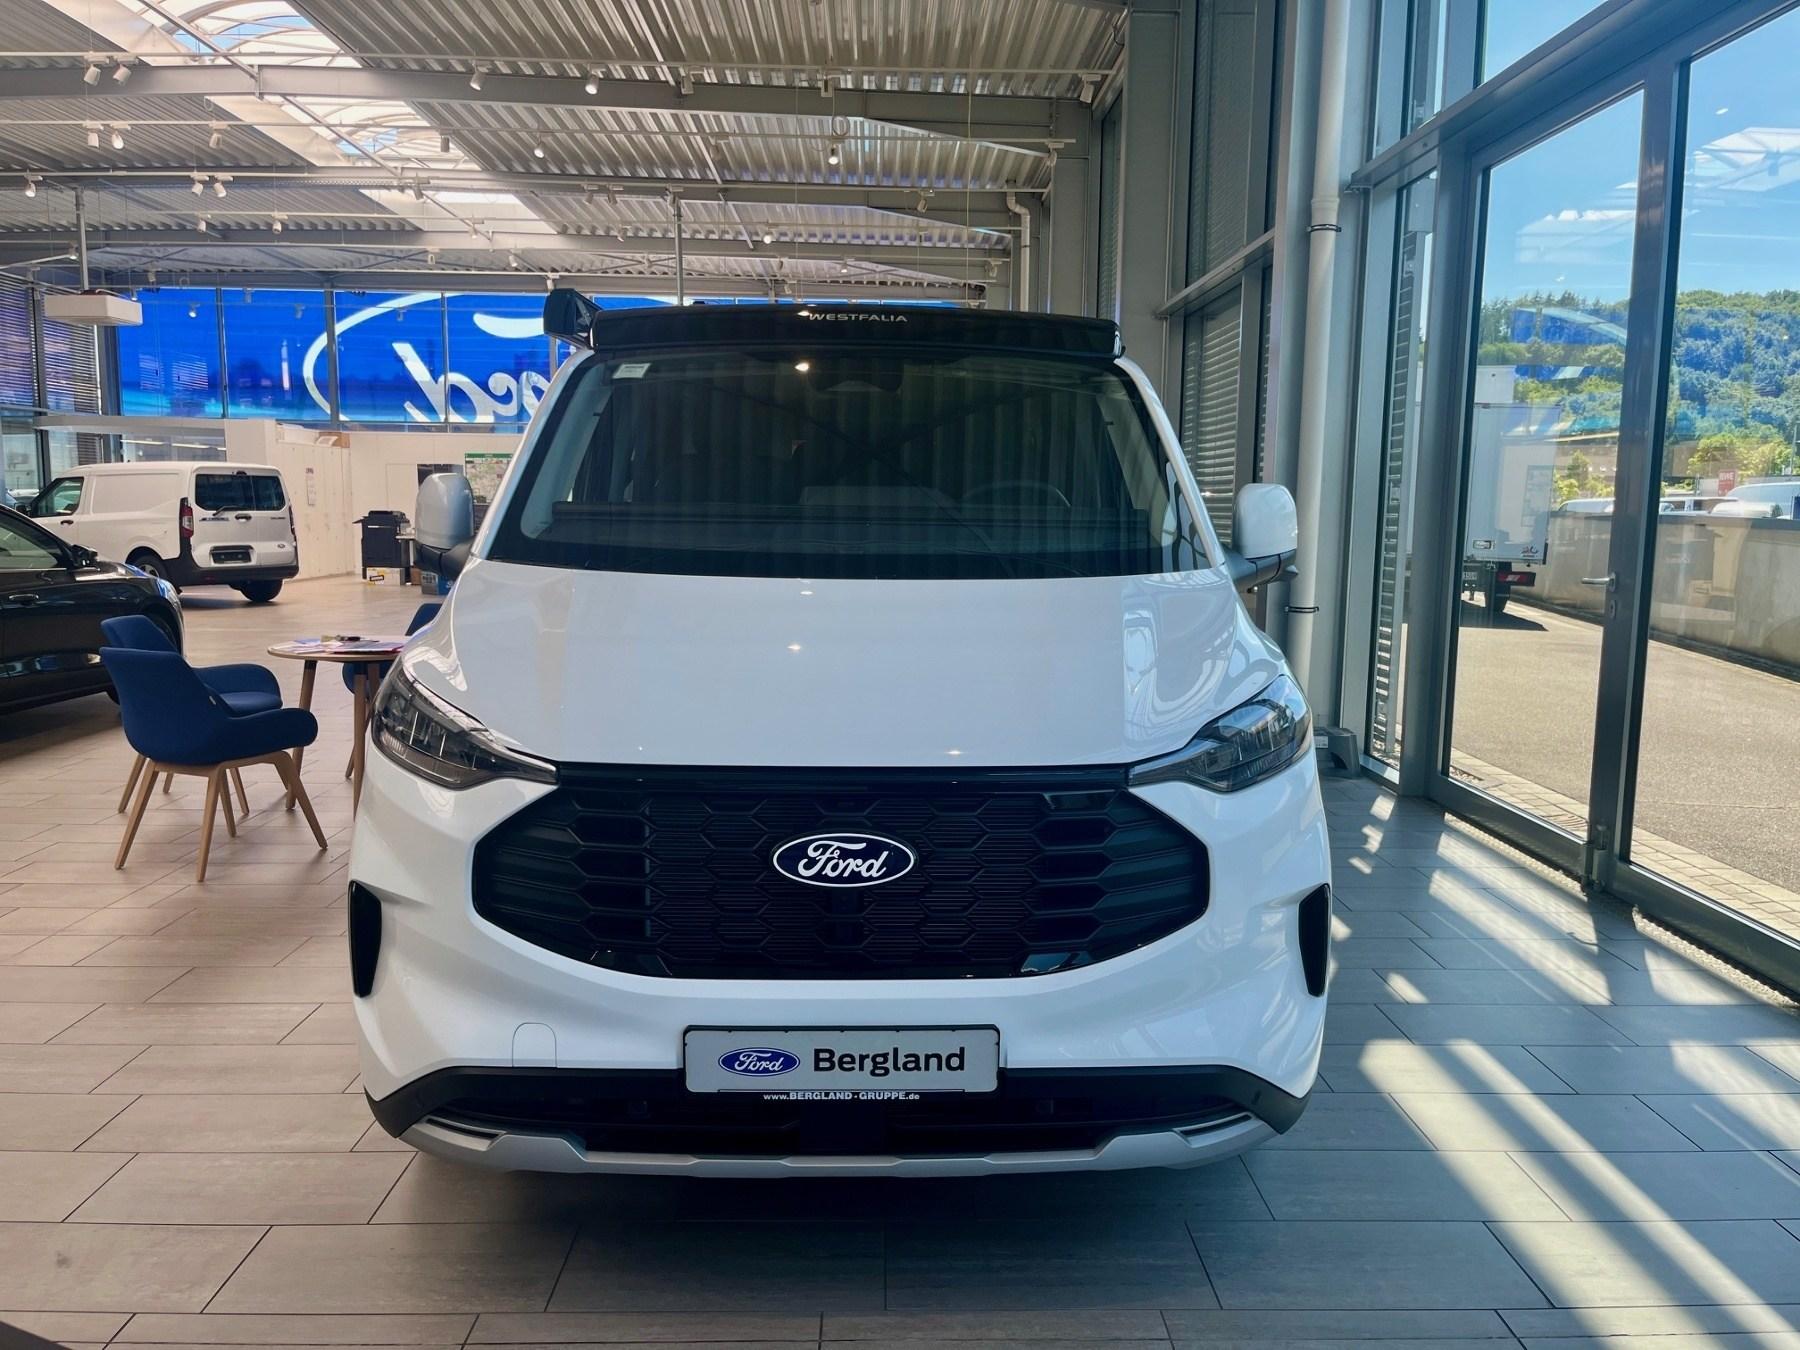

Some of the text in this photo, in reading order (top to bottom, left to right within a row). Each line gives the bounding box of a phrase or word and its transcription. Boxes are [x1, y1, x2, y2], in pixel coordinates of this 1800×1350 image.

[809, 313, 908, 322] WESTFALIA
[797, 840, 889, 878] Ford
[734, 1046, 965, 1077] Ford Bergland
